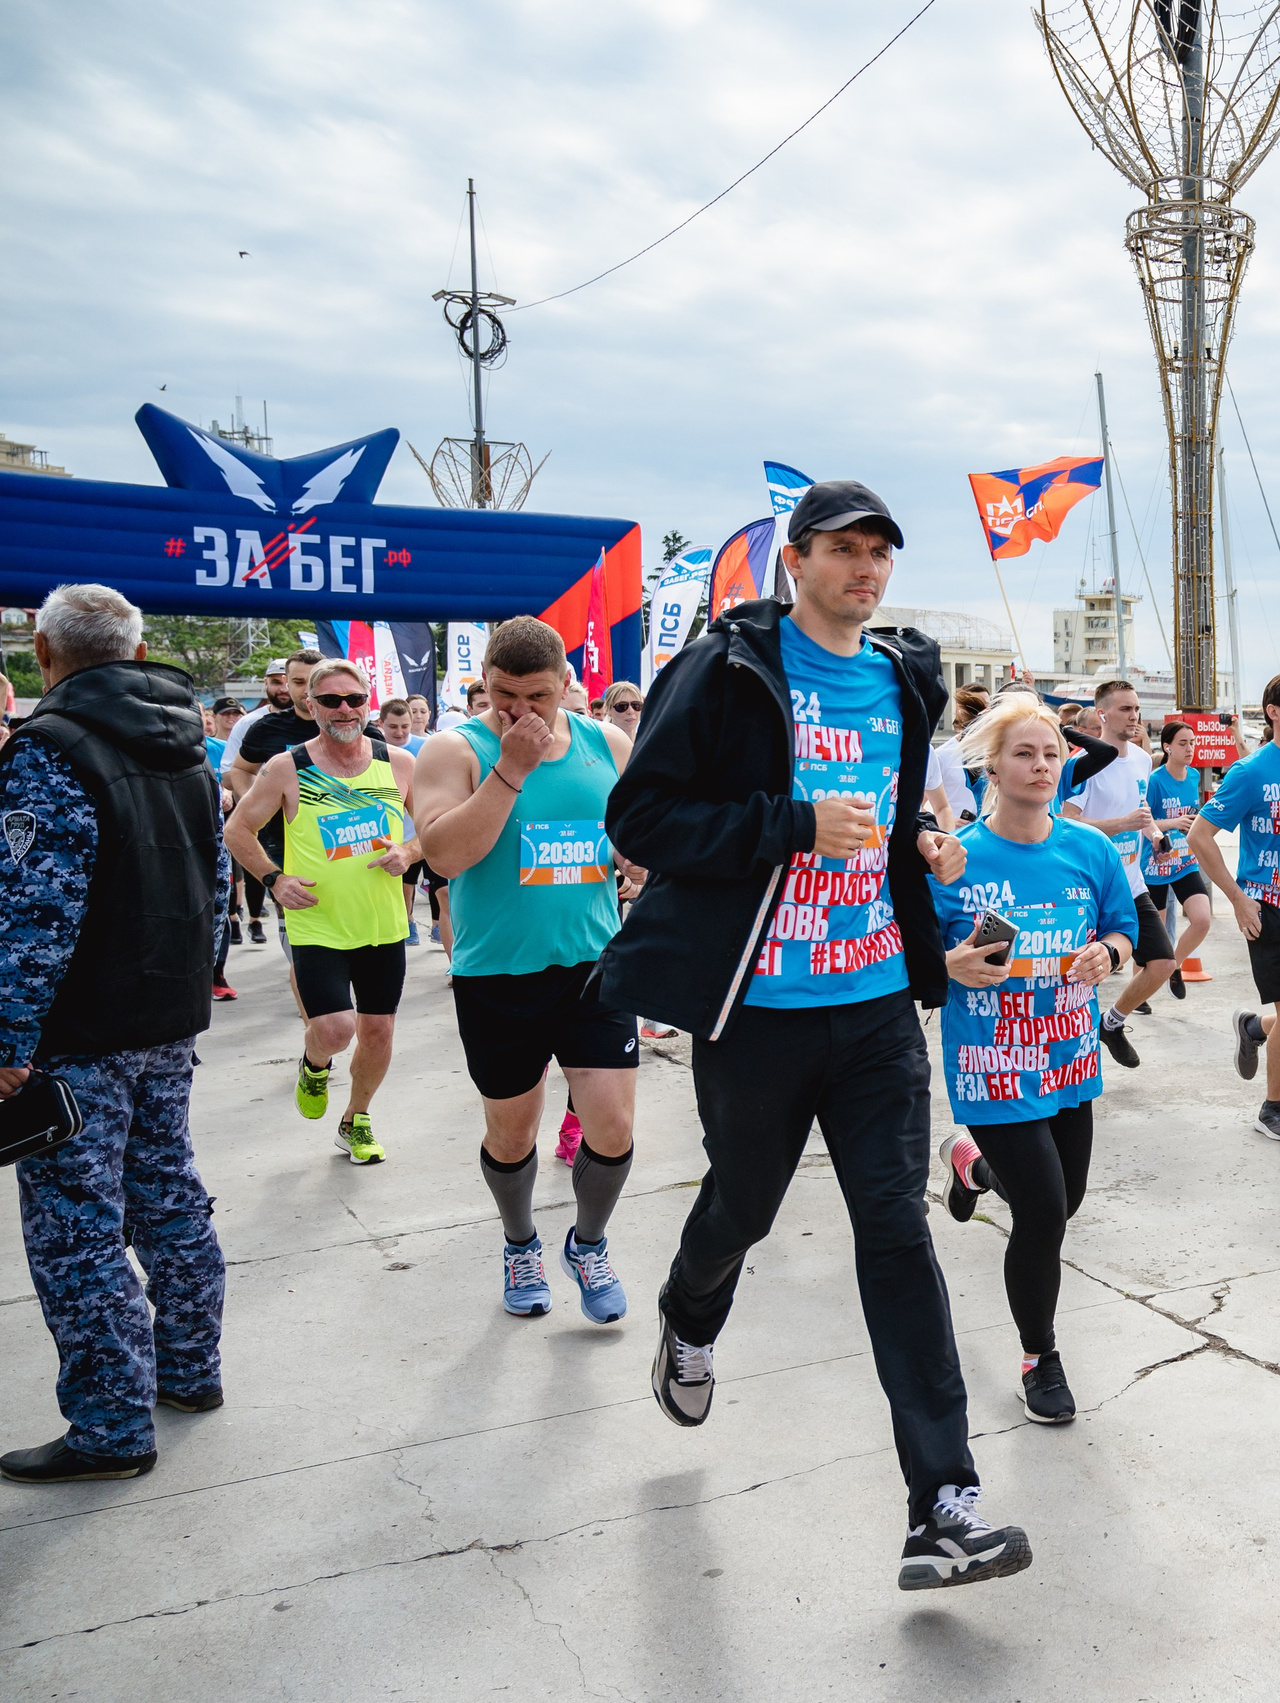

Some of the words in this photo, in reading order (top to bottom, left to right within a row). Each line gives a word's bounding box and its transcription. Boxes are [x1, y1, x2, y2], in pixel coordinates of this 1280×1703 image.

[658, 602, 682, 647] ПСБ
[790, 689, 821, 723] 24
[1197, 721, 1226, 732] ВЫЗОВ
[794, 723, 864, 763] МЕЧТА
[1198, 749, 1226, 760] СЛУЖБ
[335, 820, 379, 844] 20193
[538, 841, 594, 864] 20303
[780, 868, 886, 906] ГОРДОСТ
[959, 880, 1016, 914] 2024
[1019, 929, 1072, 955] 20142
[966, 991, 1035, 1019] #ЗАБЕГ
[958, 1045, 1050, 1072] #ЛЮБОВЬ
[956, 1072, 1024, 1102] #ЗАБЕГ
